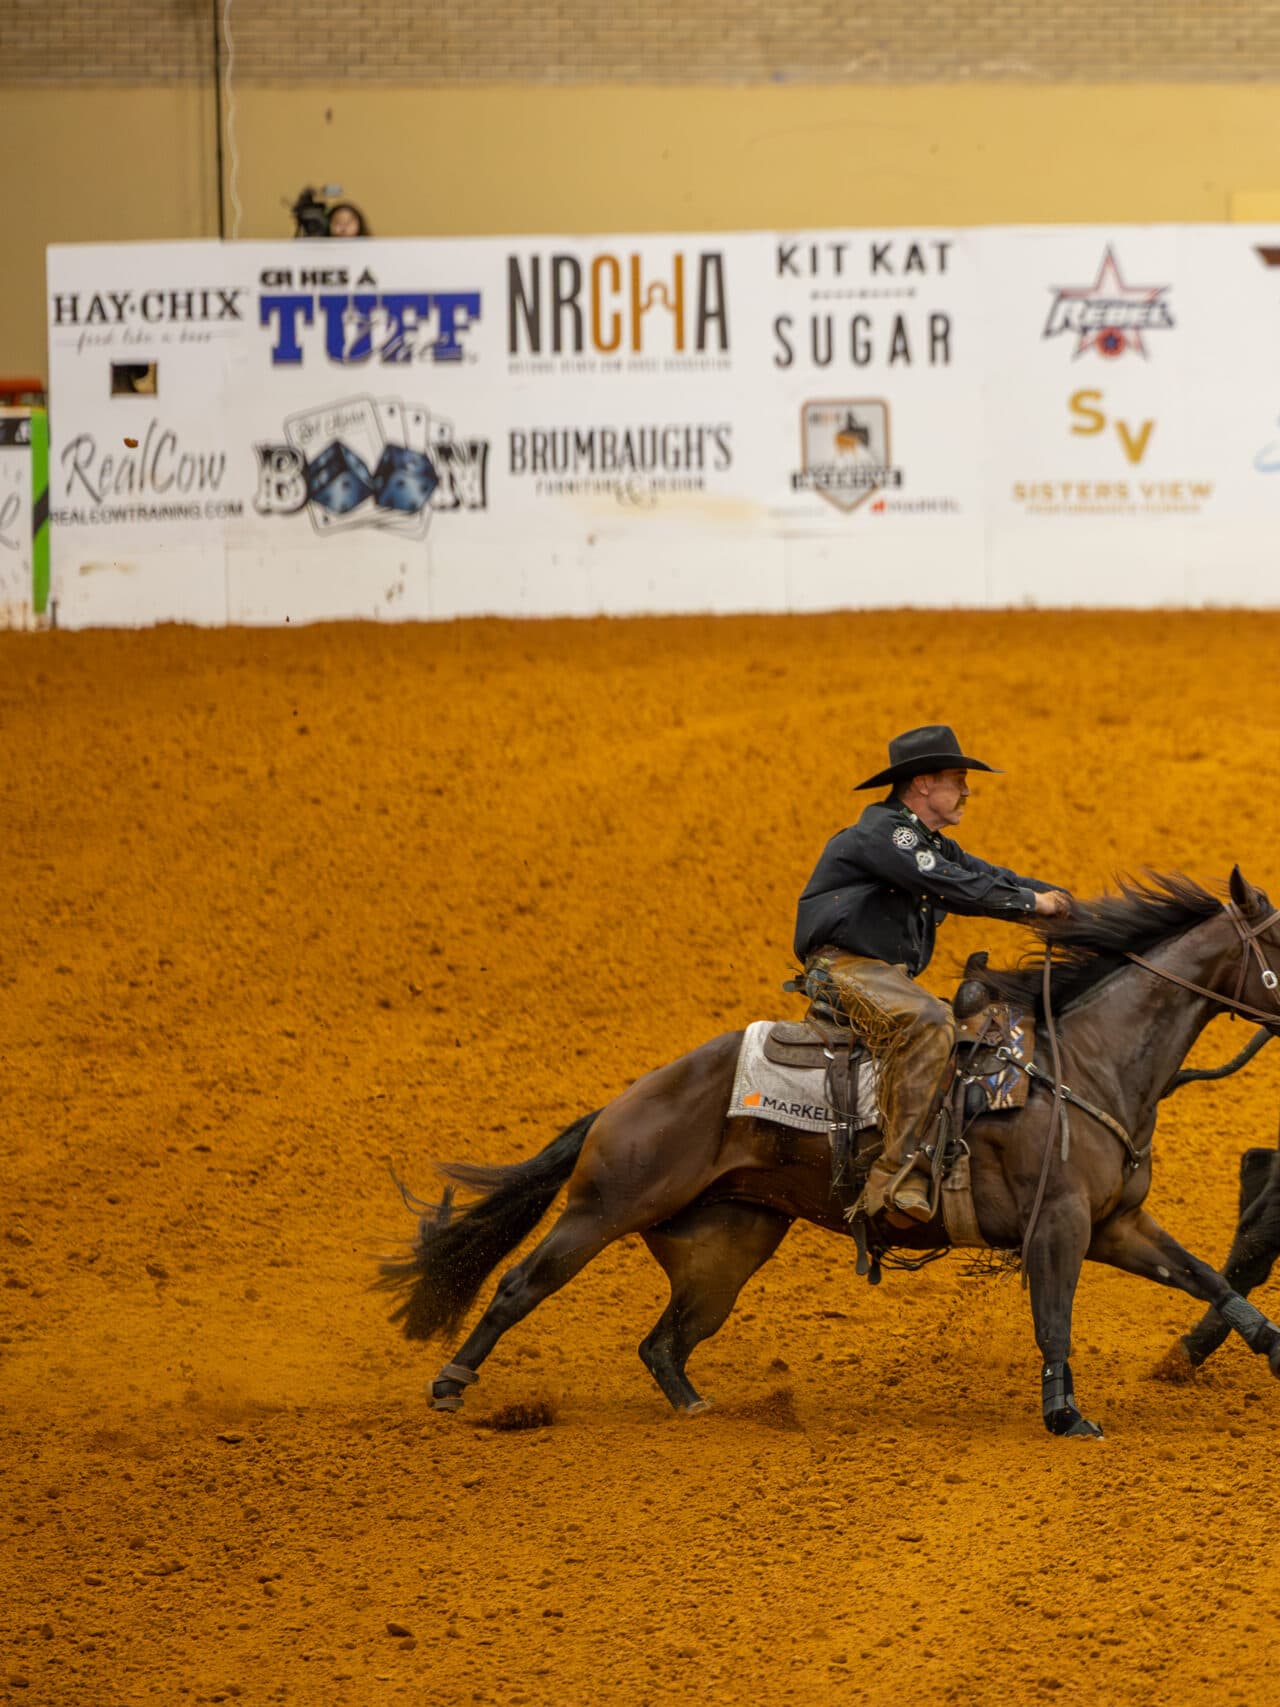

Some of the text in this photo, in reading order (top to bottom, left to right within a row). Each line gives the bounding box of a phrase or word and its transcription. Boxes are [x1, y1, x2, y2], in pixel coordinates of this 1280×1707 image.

[356, 266, 378, 287] A
[776, 241, 954, 277] KIT KAT
[259, 292, 482, 364] TUFF
[774, 313, 952, 369] SUGAR
[509, 426, 733, 475] BRUMBAUGH'S
[763, 1096, 834, 1121] MARKEL
